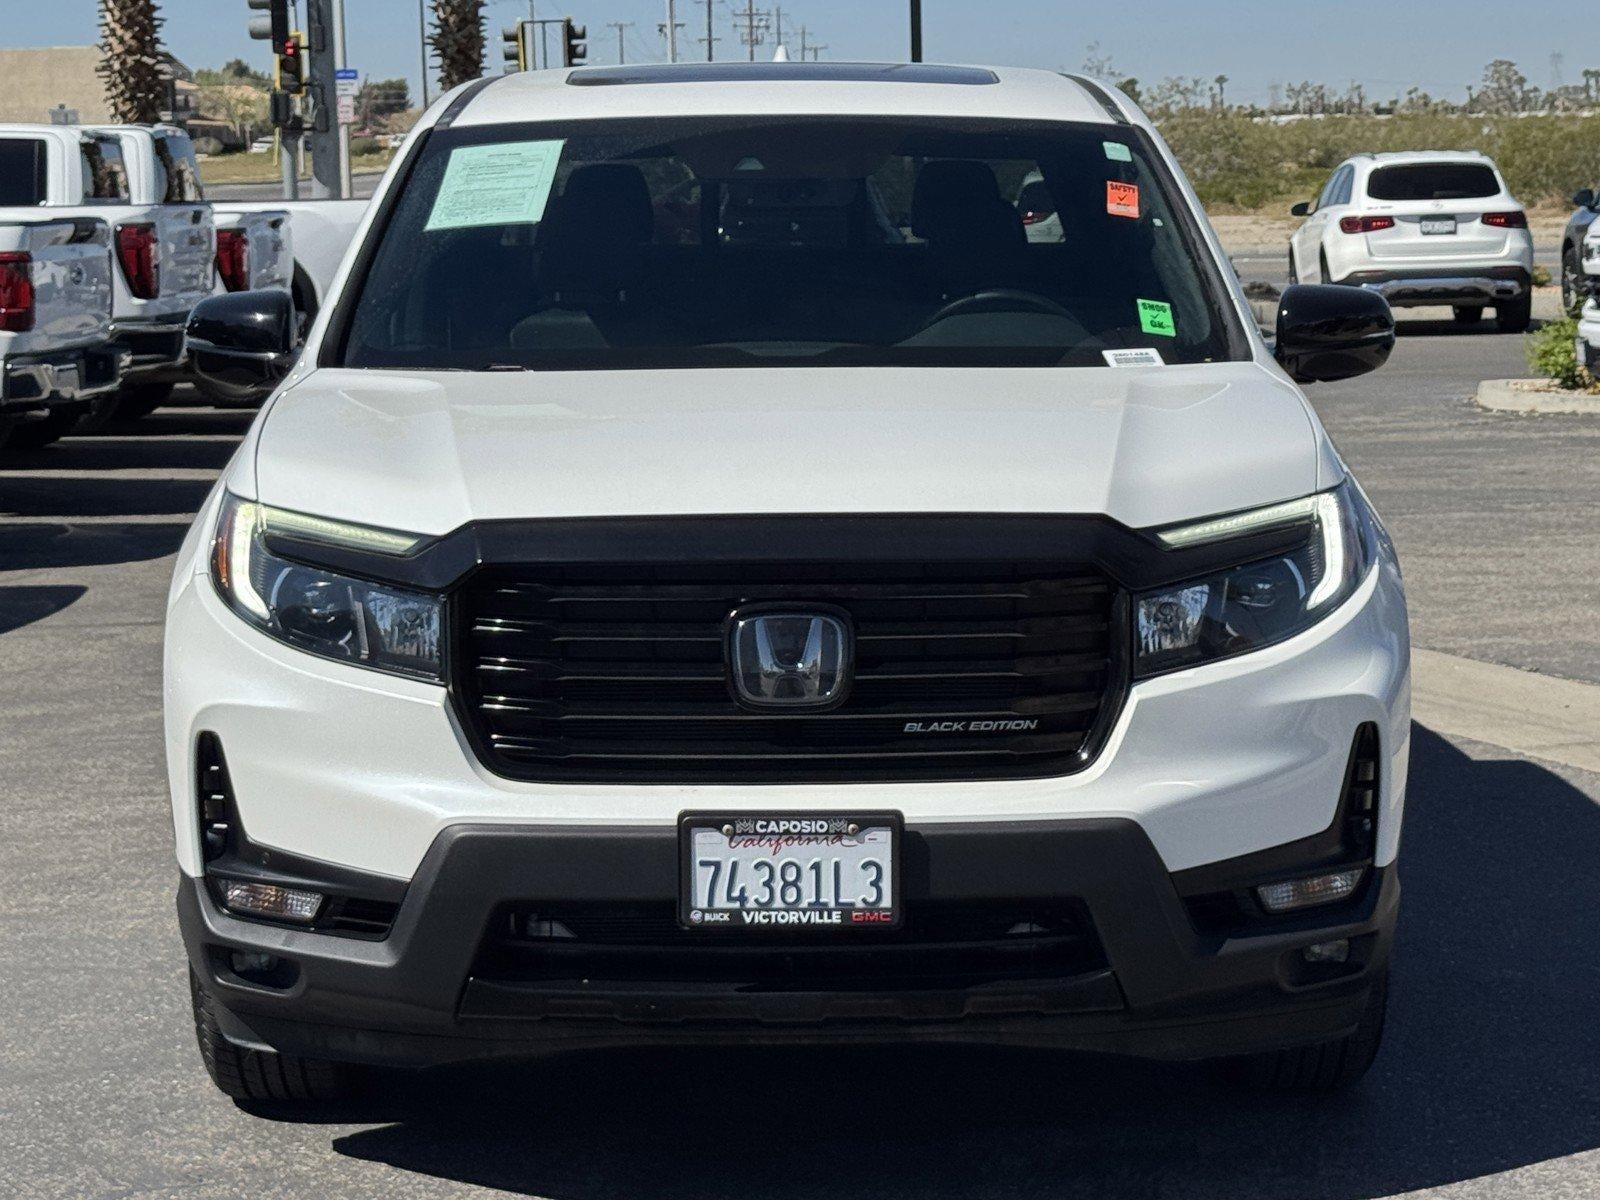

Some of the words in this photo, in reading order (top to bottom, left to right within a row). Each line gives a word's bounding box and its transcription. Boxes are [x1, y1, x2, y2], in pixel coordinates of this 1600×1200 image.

[1110, 183, 1136, 193] SAFETY
[1142, 302, 1167, 313] SMOG
[904, 721, 966, 732] BLACK
[968, 719, 1038, 731] EDITION
[755, 820, 829, 834] CAPOSIO
[728, 832, 860, 856] California
[699, 859, 884, 908] 74381L3
[704, 912, 731, 922] BUICK
[742, 910, 842, 924] VICTORVILLE
[852, 911, 893, 922] GMC
